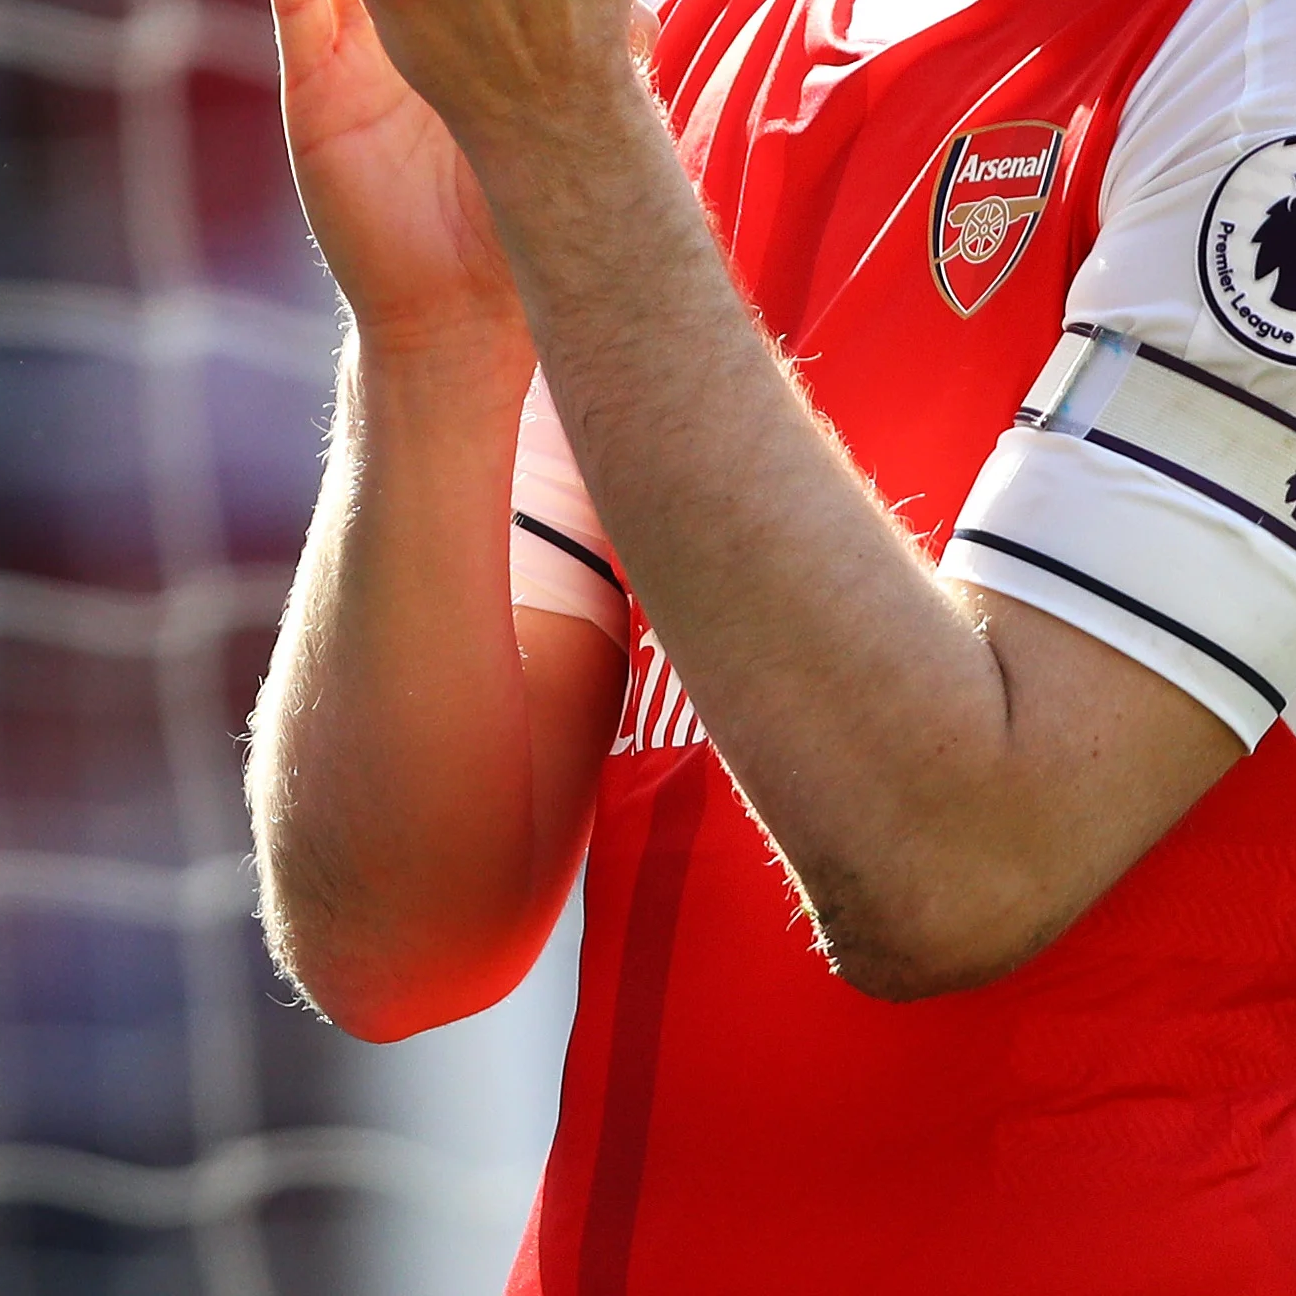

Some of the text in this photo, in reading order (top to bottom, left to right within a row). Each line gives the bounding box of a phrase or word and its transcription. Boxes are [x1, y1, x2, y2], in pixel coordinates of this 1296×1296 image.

[957, 148, 1048, 184] Arsenal
[1214, 220, 1295, 344] Premier League
